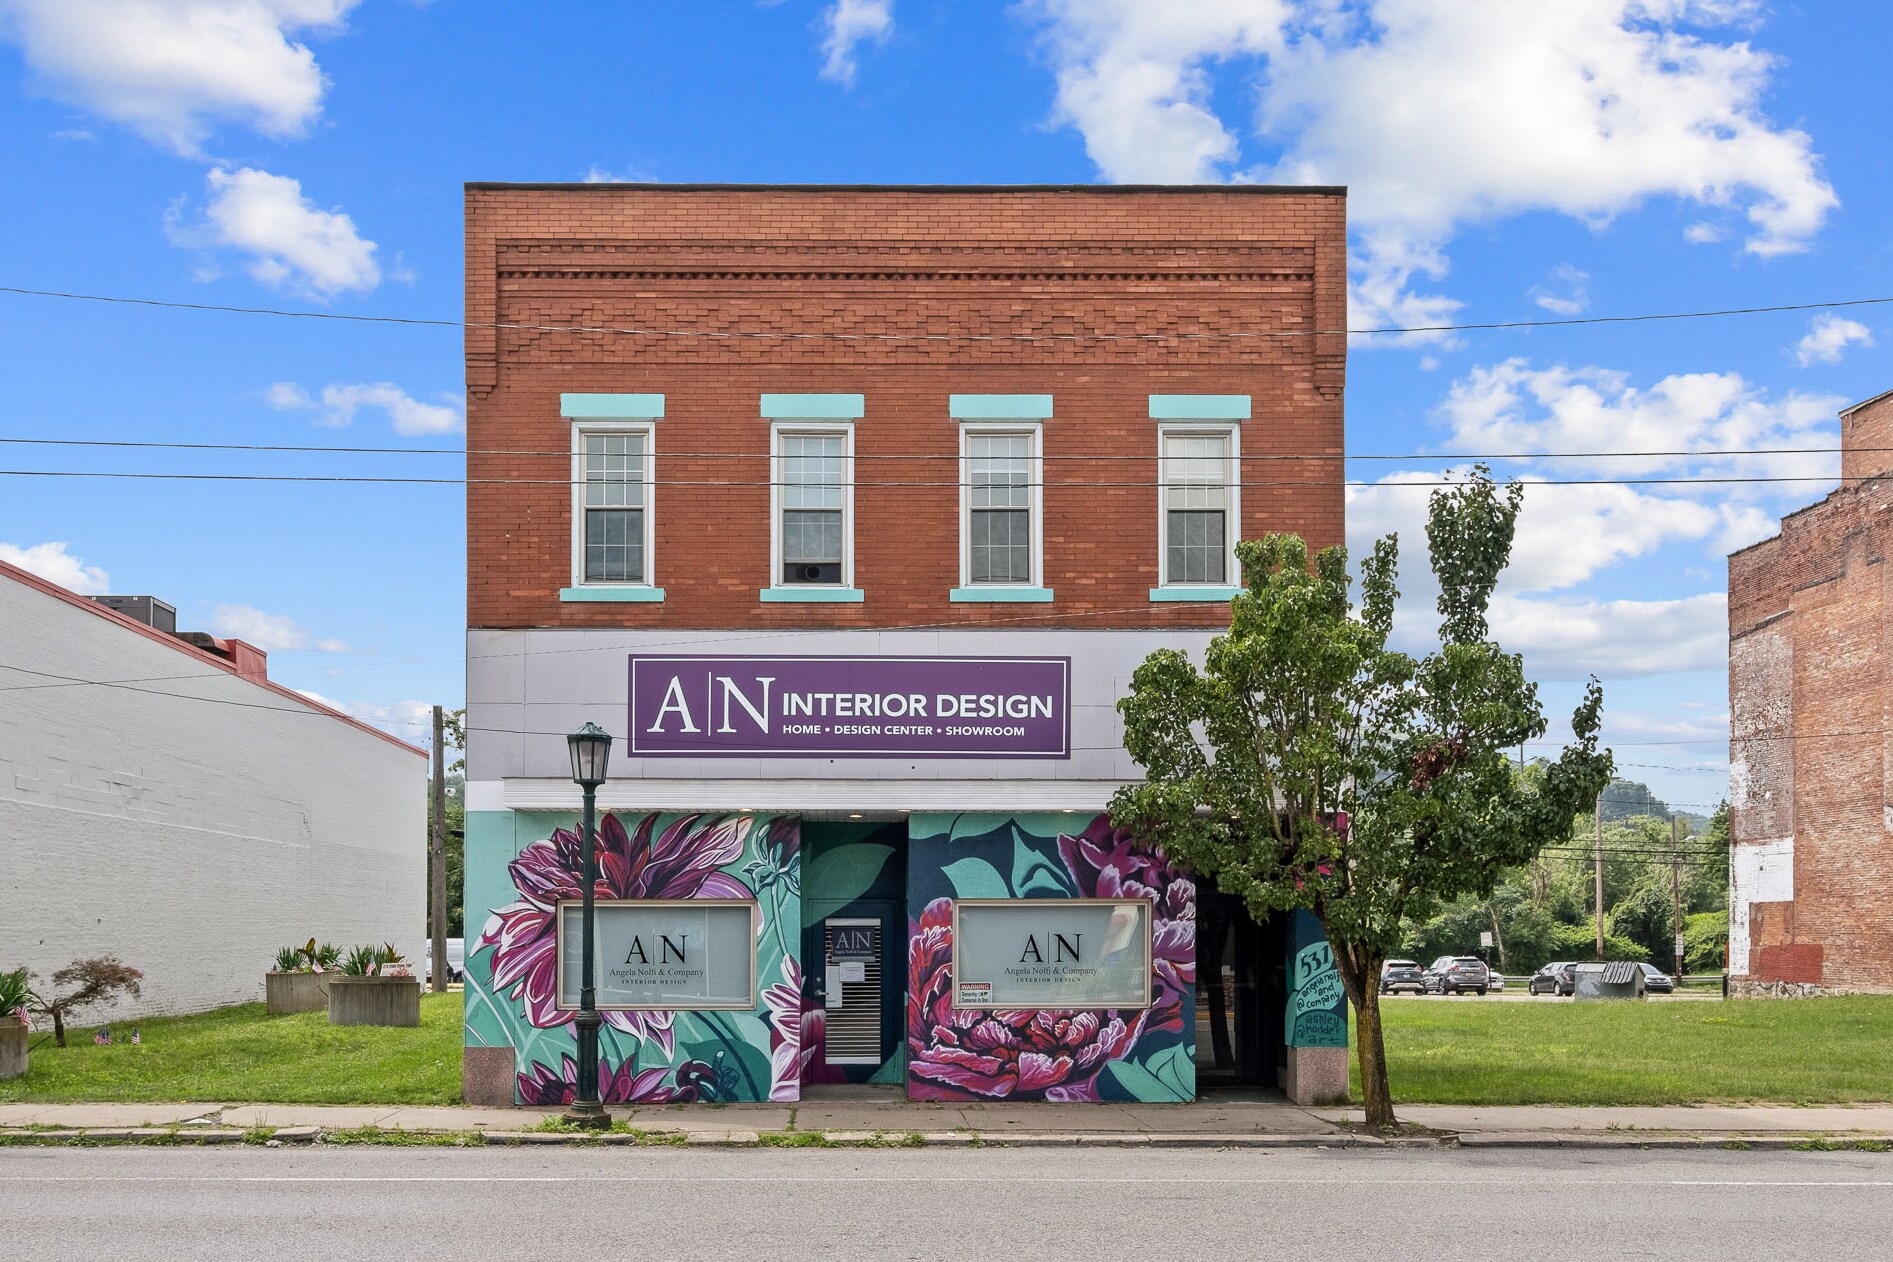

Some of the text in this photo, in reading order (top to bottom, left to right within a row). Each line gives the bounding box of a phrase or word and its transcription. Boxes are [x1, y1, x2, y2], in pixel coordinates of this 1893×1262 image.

[782, 693, 1053, 719] INTERIOR DESIGN
[782, 725, 1025, 737] HOME DESIGN CENTER SHOWROOM
[1300, 945, 1330, 978] 531
[609, 967, 704, 978] Angela Nolfi & Company
[1004, 966, 1098, 977] Angela Nolfi & Company
[1318, 981, 1335, 996] and
[1306, 1014, 1340, 1028] ashley
[1308, 1035, 1341, 1044] art
